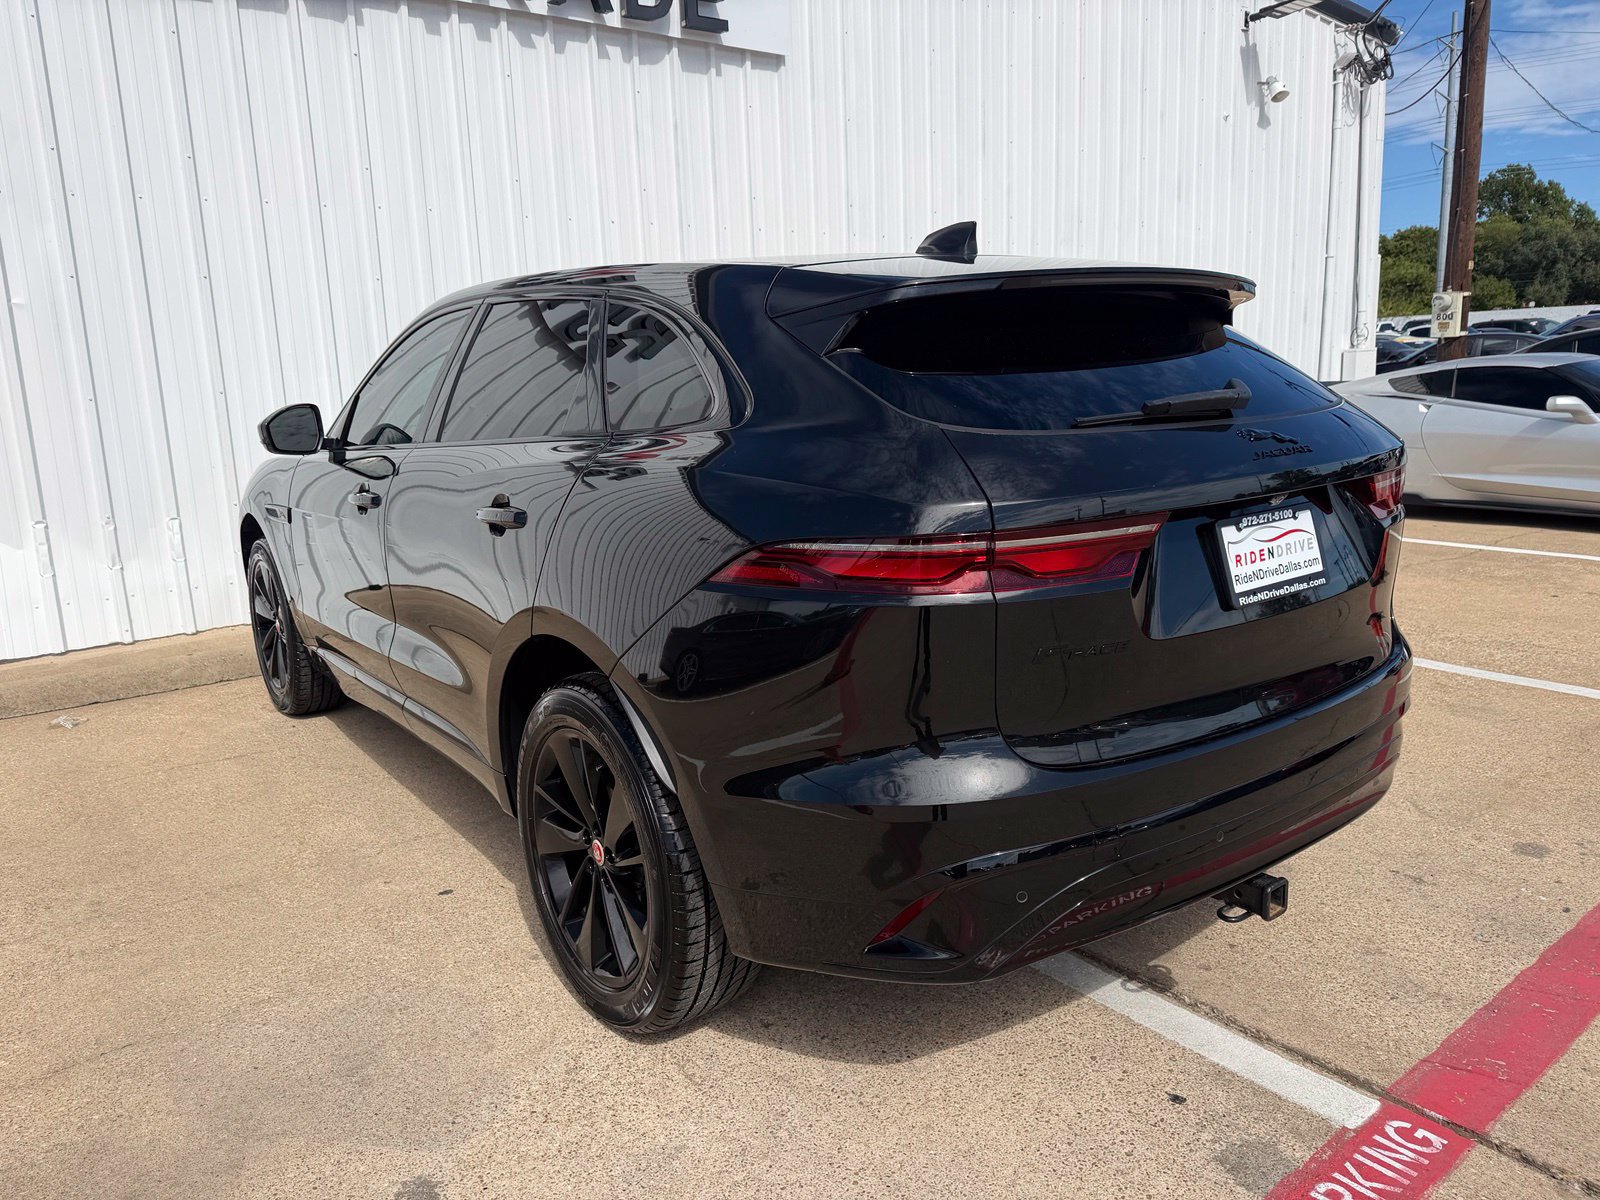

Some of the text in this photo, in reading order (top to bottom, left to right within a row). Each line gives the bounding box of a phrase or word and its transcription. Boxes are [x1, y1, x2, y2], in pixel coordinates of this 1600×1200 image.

[1241, 509, 1293, 527] 972-271-5100
[1234, 537, 1314, 568] RIDENDRIVE
[1234, 556, 1320, 587] RideNDriveDallas.com
[1239, 577, 1326, 606] RideNDriveDallas.com
